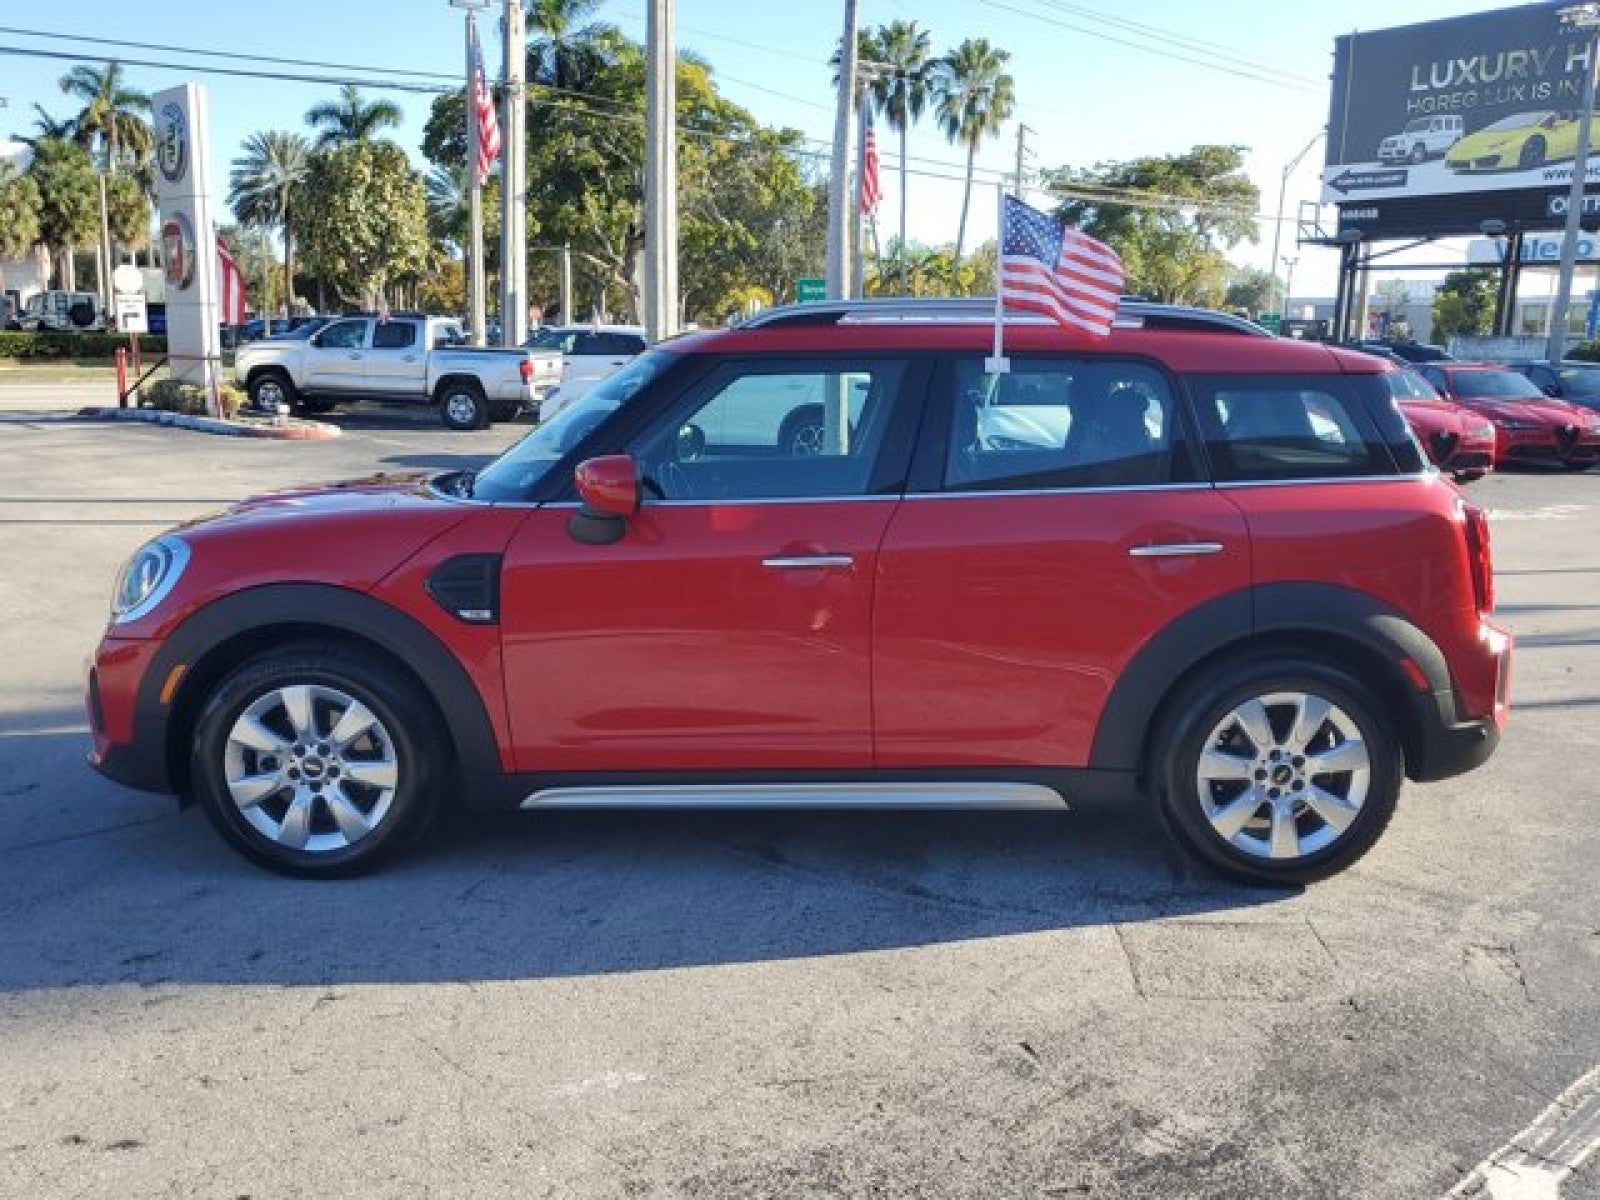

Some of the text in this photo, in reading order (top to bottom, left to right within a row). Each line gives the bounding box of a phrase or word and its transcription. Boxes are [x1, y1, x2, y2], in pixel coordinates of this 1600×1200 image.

[1409, 46, 1555, 91] LUXURY
[1406, 90, 1478, 114] HGREG
[1532, 82, 1551, 101] IS
